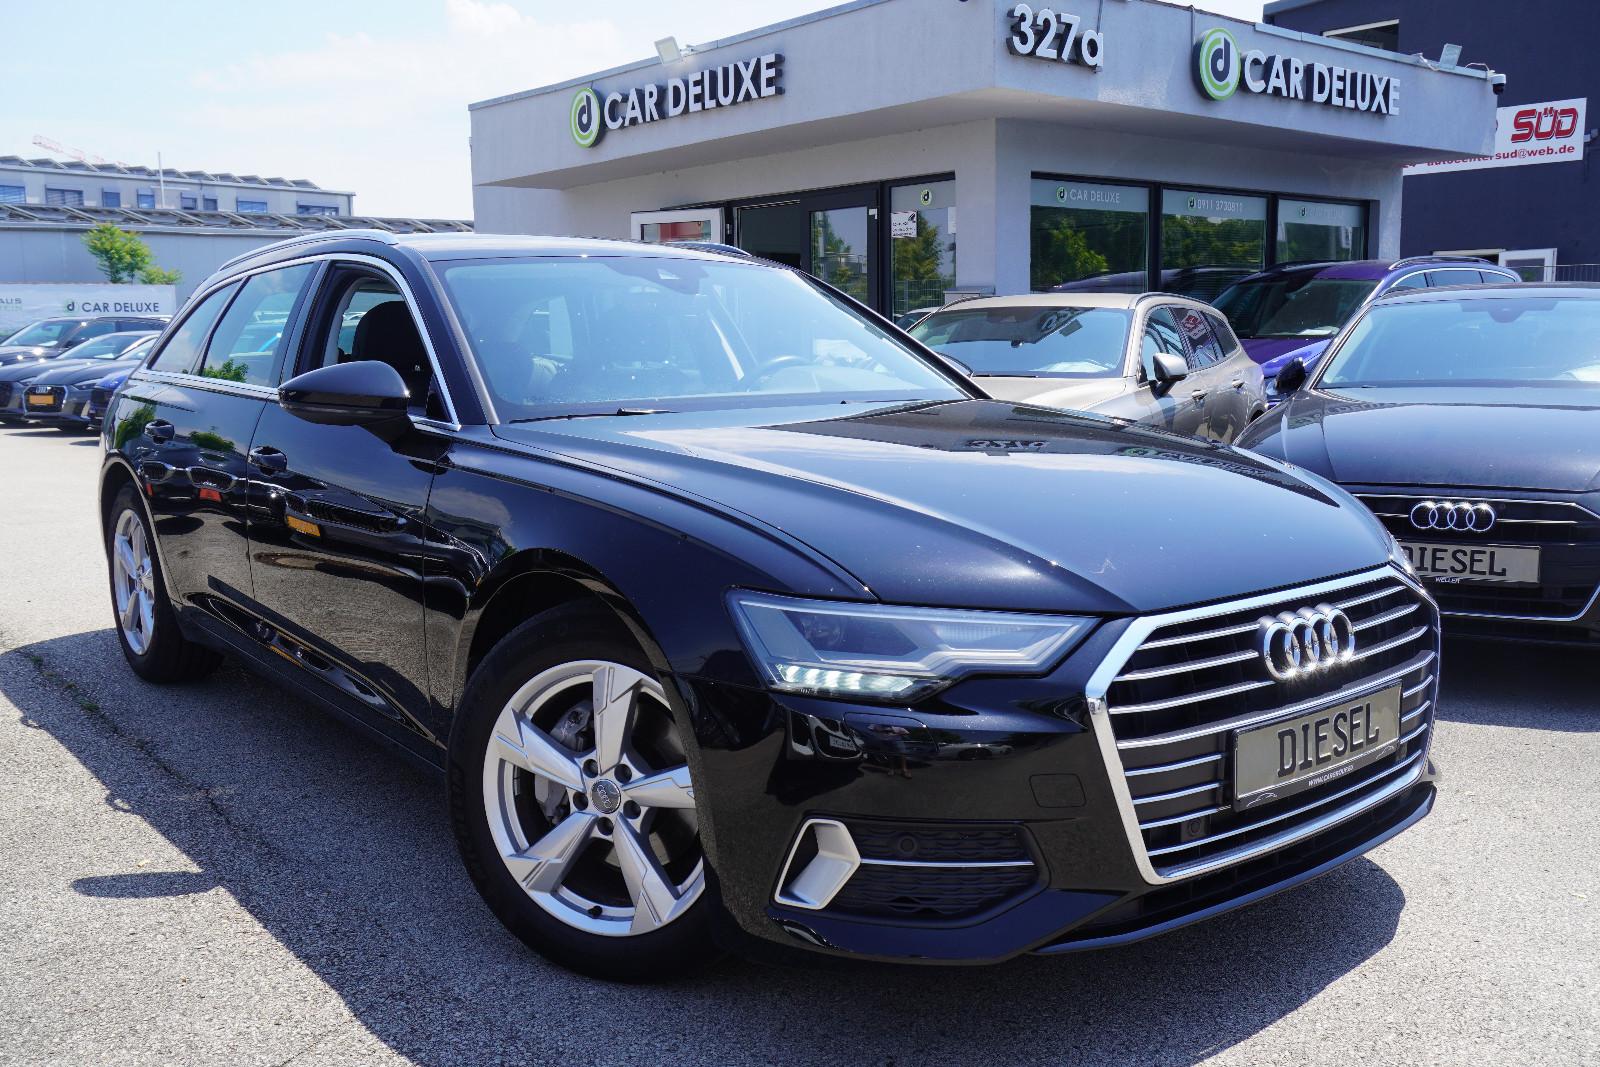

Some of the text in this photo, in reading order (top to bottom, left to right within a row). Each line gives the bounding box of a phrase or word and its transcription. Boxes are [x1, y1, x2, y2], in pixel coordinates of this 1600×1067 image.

[1013, 4, 1103, 67] 327a
[604, 83, 659, 130] CAR
[668, 53, 776, 117] DELUXE
[1244, 49, 1304, 99] CAR
[1312, 62, 1400, 115] DELUXE
[1511, 106, 1578, 143] SÜD
[1069, 189, 1088, 201] CAR
[1090, 191, 1120, 204] DELUXE
[81, 302, 109, 312] CAR
[114, 302, 159, 312] DELUXE
[1277, 702, 1380, 777] DIESEL
